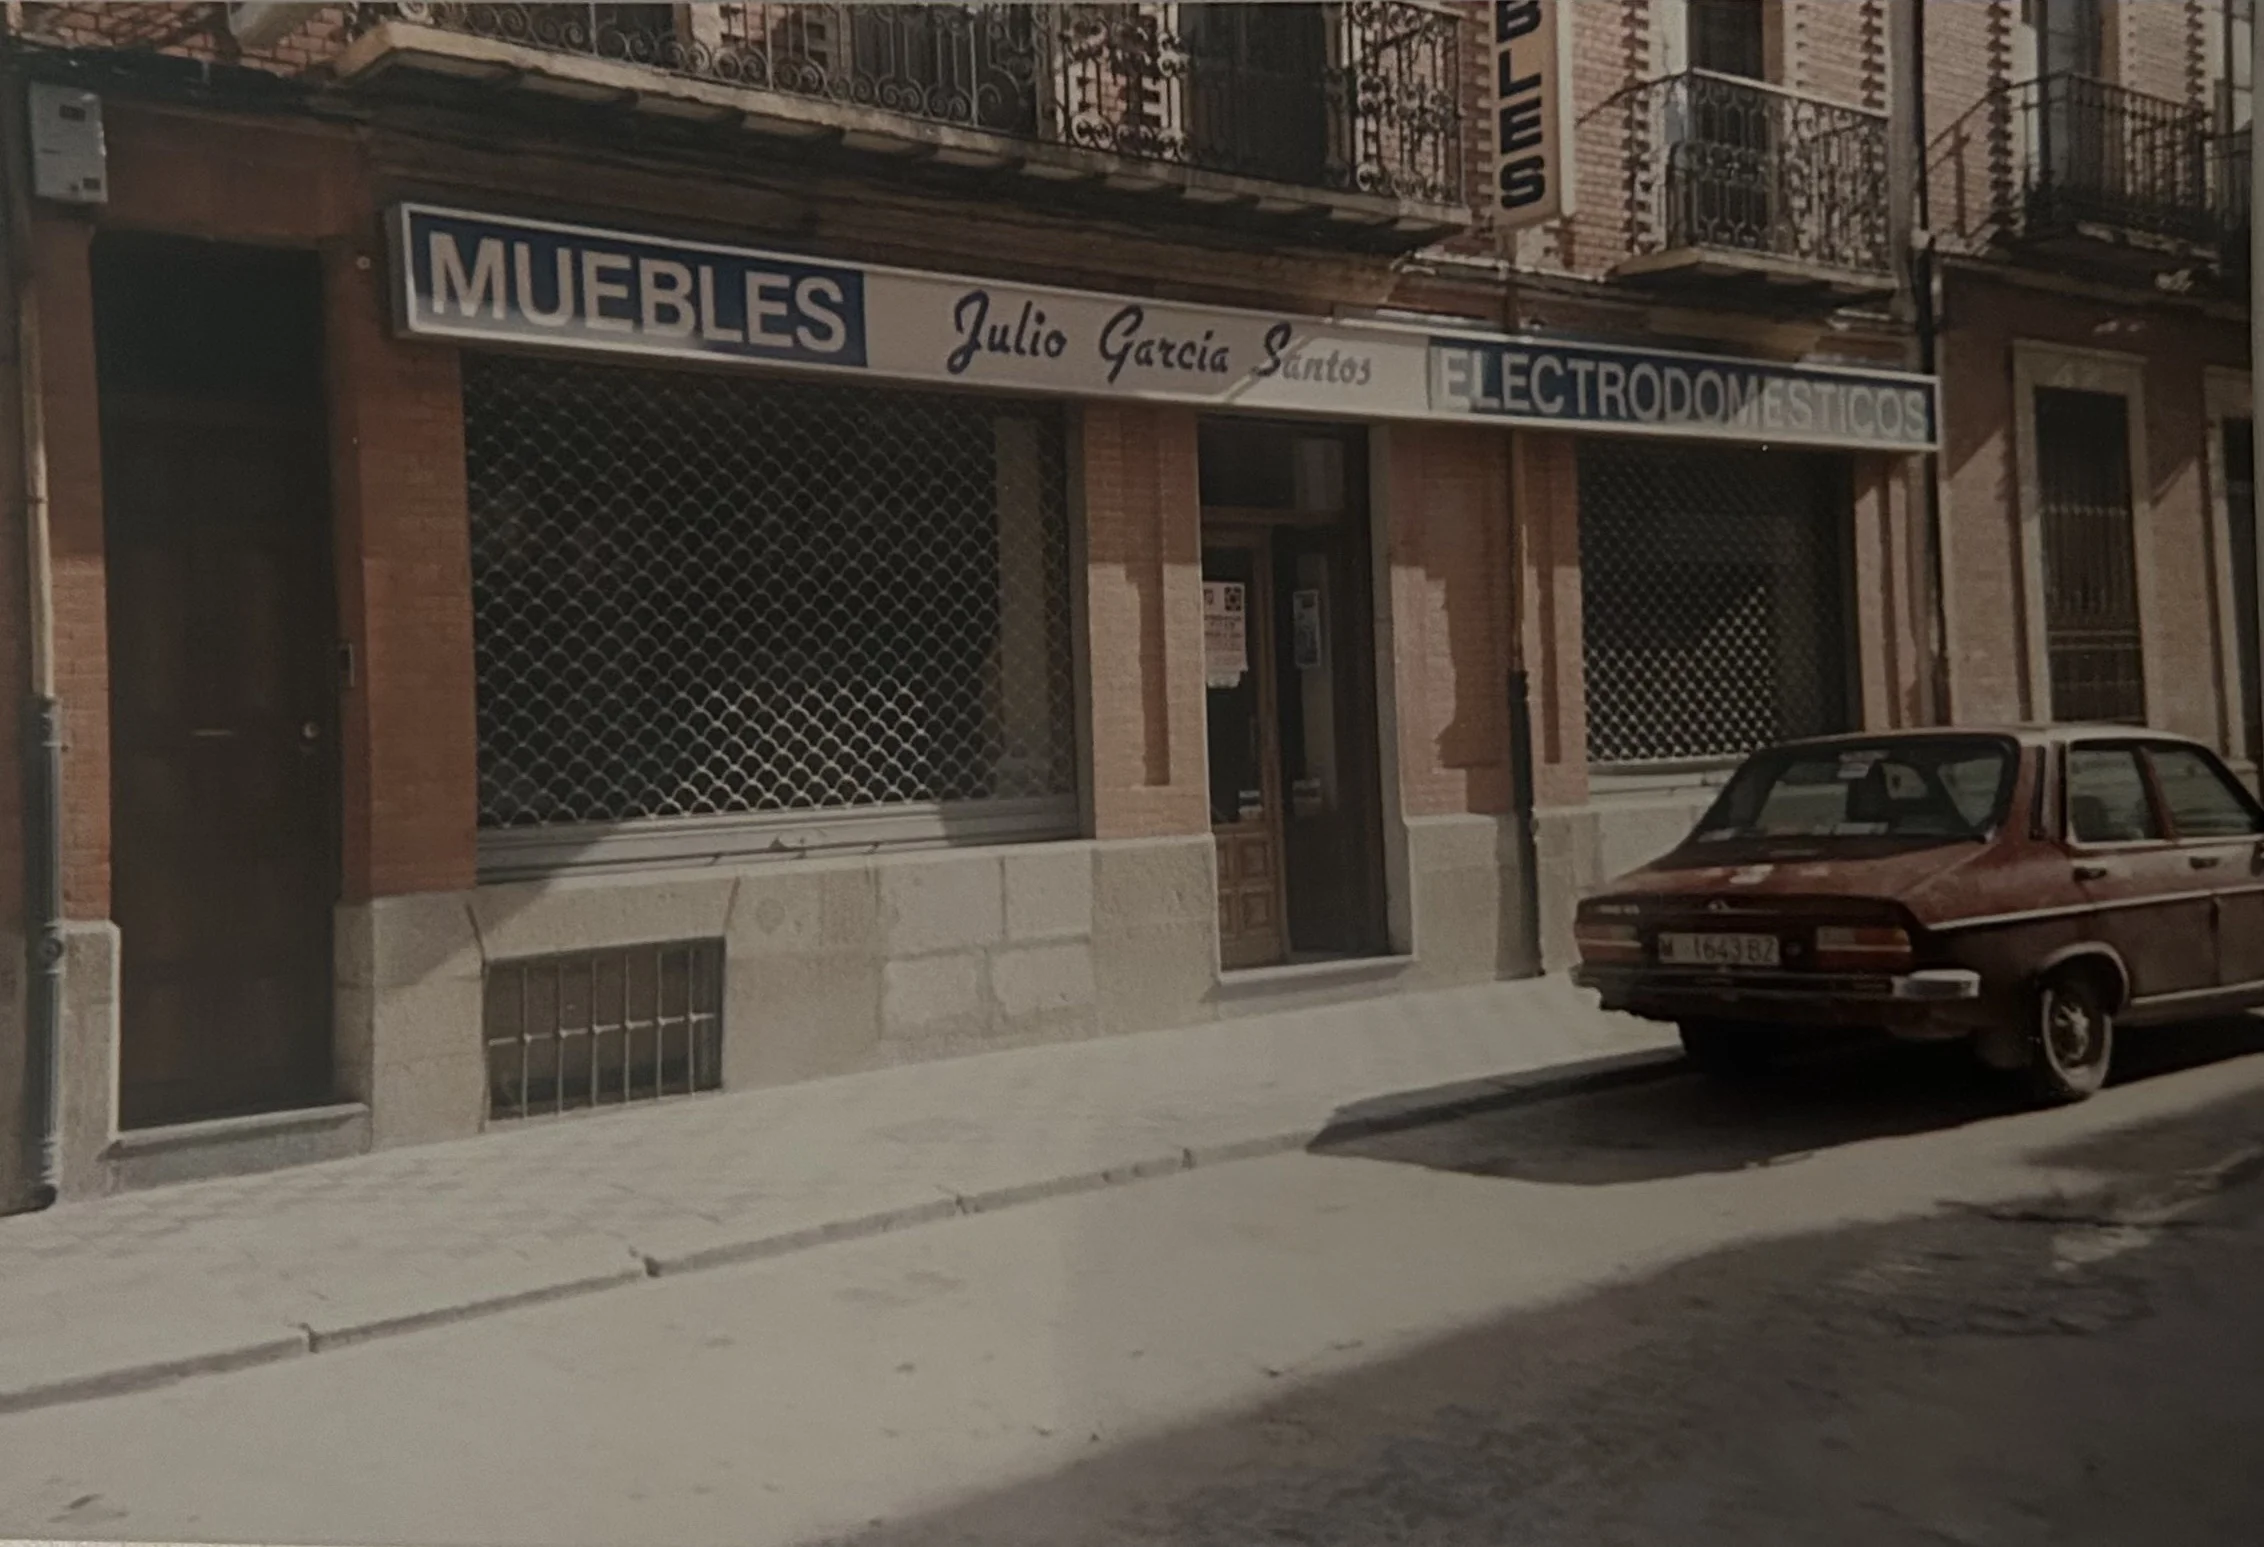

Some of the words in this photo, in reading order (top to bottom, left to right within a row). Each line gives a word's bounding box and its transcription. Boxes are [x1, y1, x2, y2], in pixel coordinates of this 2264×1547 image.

[428, 230, 846, 353] MUEBLES
[946, 288, 1068, 375] Julio
[1251, 320, 1372, 386] Santos
[1440, 348, 1926, 437] ELECTRODOMESTICOS
